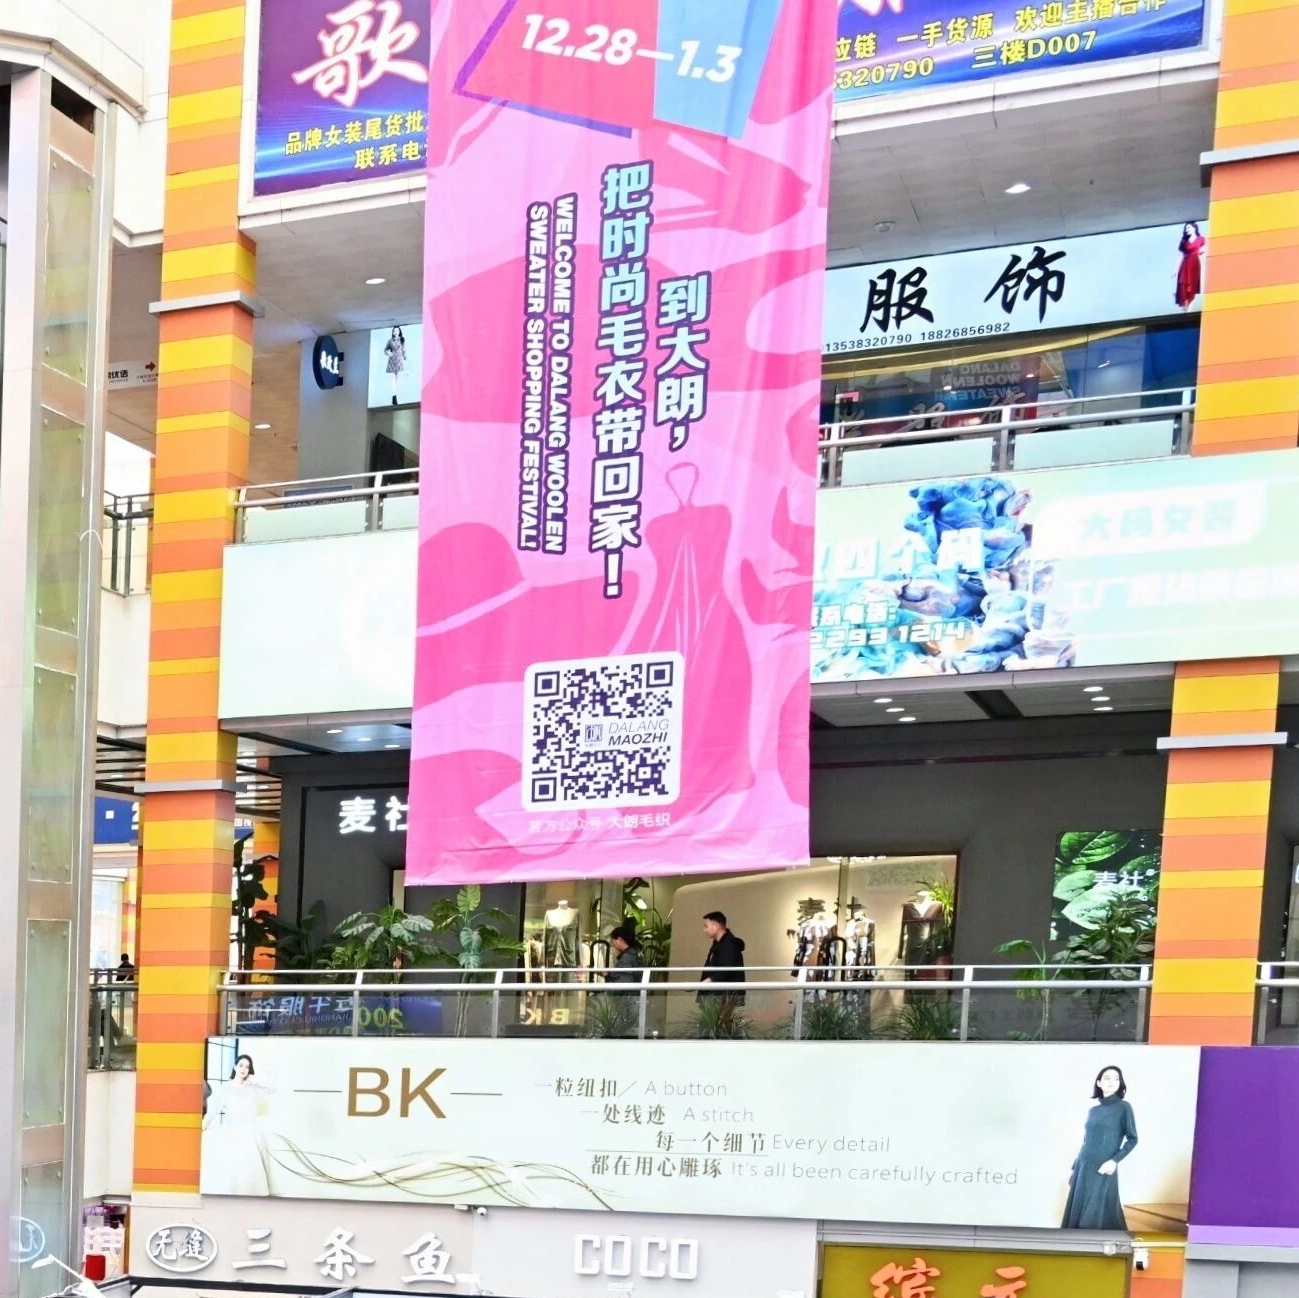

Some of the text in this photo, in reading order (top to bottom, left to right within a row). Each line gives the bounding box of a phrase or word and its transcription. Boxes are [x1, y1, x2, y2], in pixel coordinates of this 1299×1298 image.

[897, 12, 994, 48] 一手货源
[292, 0, 429, 108] 歌
[834, 32, 1097, 90] 320790 三楼D007
[284, 110, 429, 156] 品牌女装尾货批
[355, 142, 428, 170] 联系电
[860, 246, 1067, 334] 服饰
[825, 322, 1011, 353] 13538320790 18826856982
[518, 202, 549, 551] SWEATER SHOPPING FESTIVAL!
[543, 194, 577, 554] WELCOME TO DALANG WOOLEN
[607, 731, 669, 748] MAOZHI
[608, 717, 670, 733] DALANG
[346, 1066, 449, 1119] BK
[644, 1079, 728, 1097] A button
[683, 1106, 698, 1122] A
[700, 1105, 755, 1123] stitch
[771, 1133, 828, 1155] Every
[833, 1134, 891, 1153] detail
[764, 1161, 787, 1179] all
[792, 1162, 842, 1181] been
[847, 1163, 936, 1187] carefully
[941, 1167, 1019, 1186] crafted
[232, 1225, 461, 1285] 三条鱼
[574, 1233, 699, 1281] COCO
